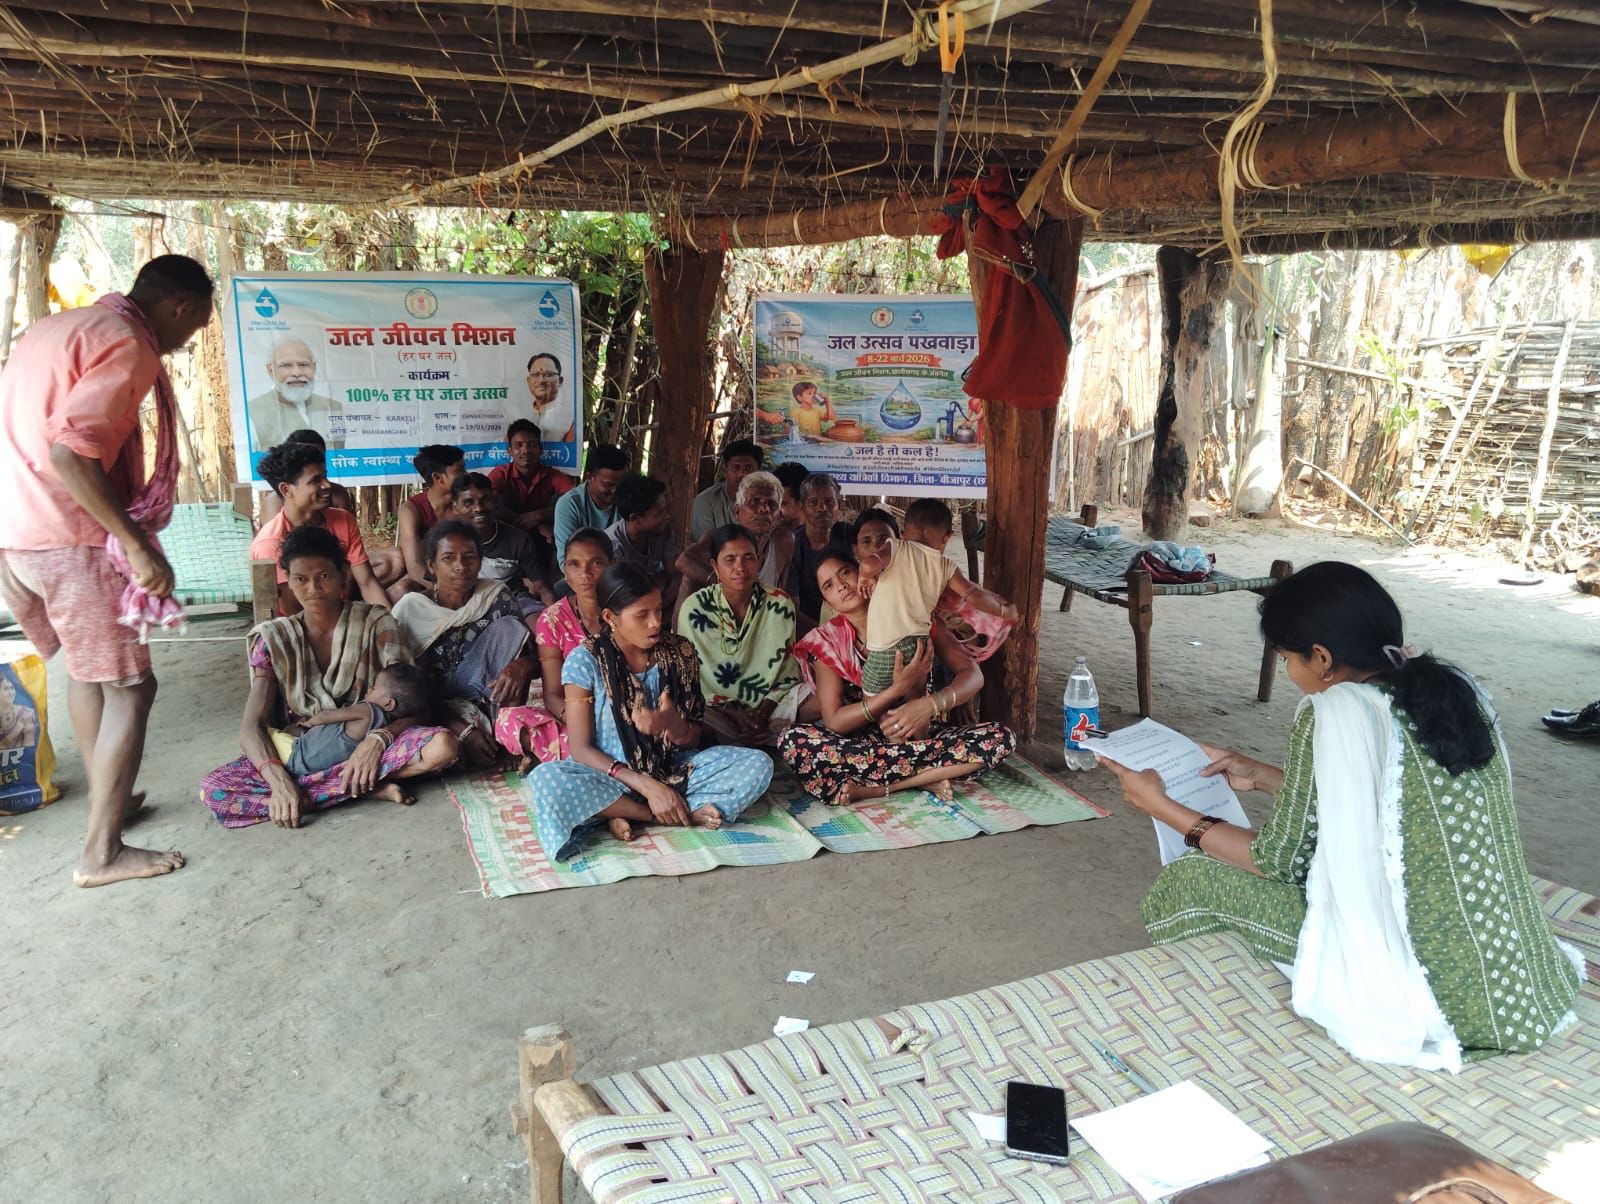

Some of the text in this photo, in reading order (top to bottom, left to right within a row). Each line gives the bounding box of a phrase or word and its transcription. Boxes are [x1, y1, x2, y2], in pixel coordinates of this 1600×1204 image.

[325, 322, 516, 346] जल जीवन मिशन
[827, 335, 977, 353] जल उत्सव पखवाड़ा
[397, 350, 457, 364] (हर घर जल)
[867, 354, 888, 363] 8-22
[906, 354, 931, 363] 2026
[407, 368, 450, 381] कार्यक्रम
[345, 386, 509, 402] 100% हर घर जल उत्सव
[435, 423, 456, 432] दिनांक
[855, 444, 939, 457] जल है तो कल है!
[331, 455, 358, 468] लोक
[362, 455, 402, 467] स्वास्थ्य
[881, 472, 911, 483] विभाग,
[940, 474, 970, 486] बीजापुर
